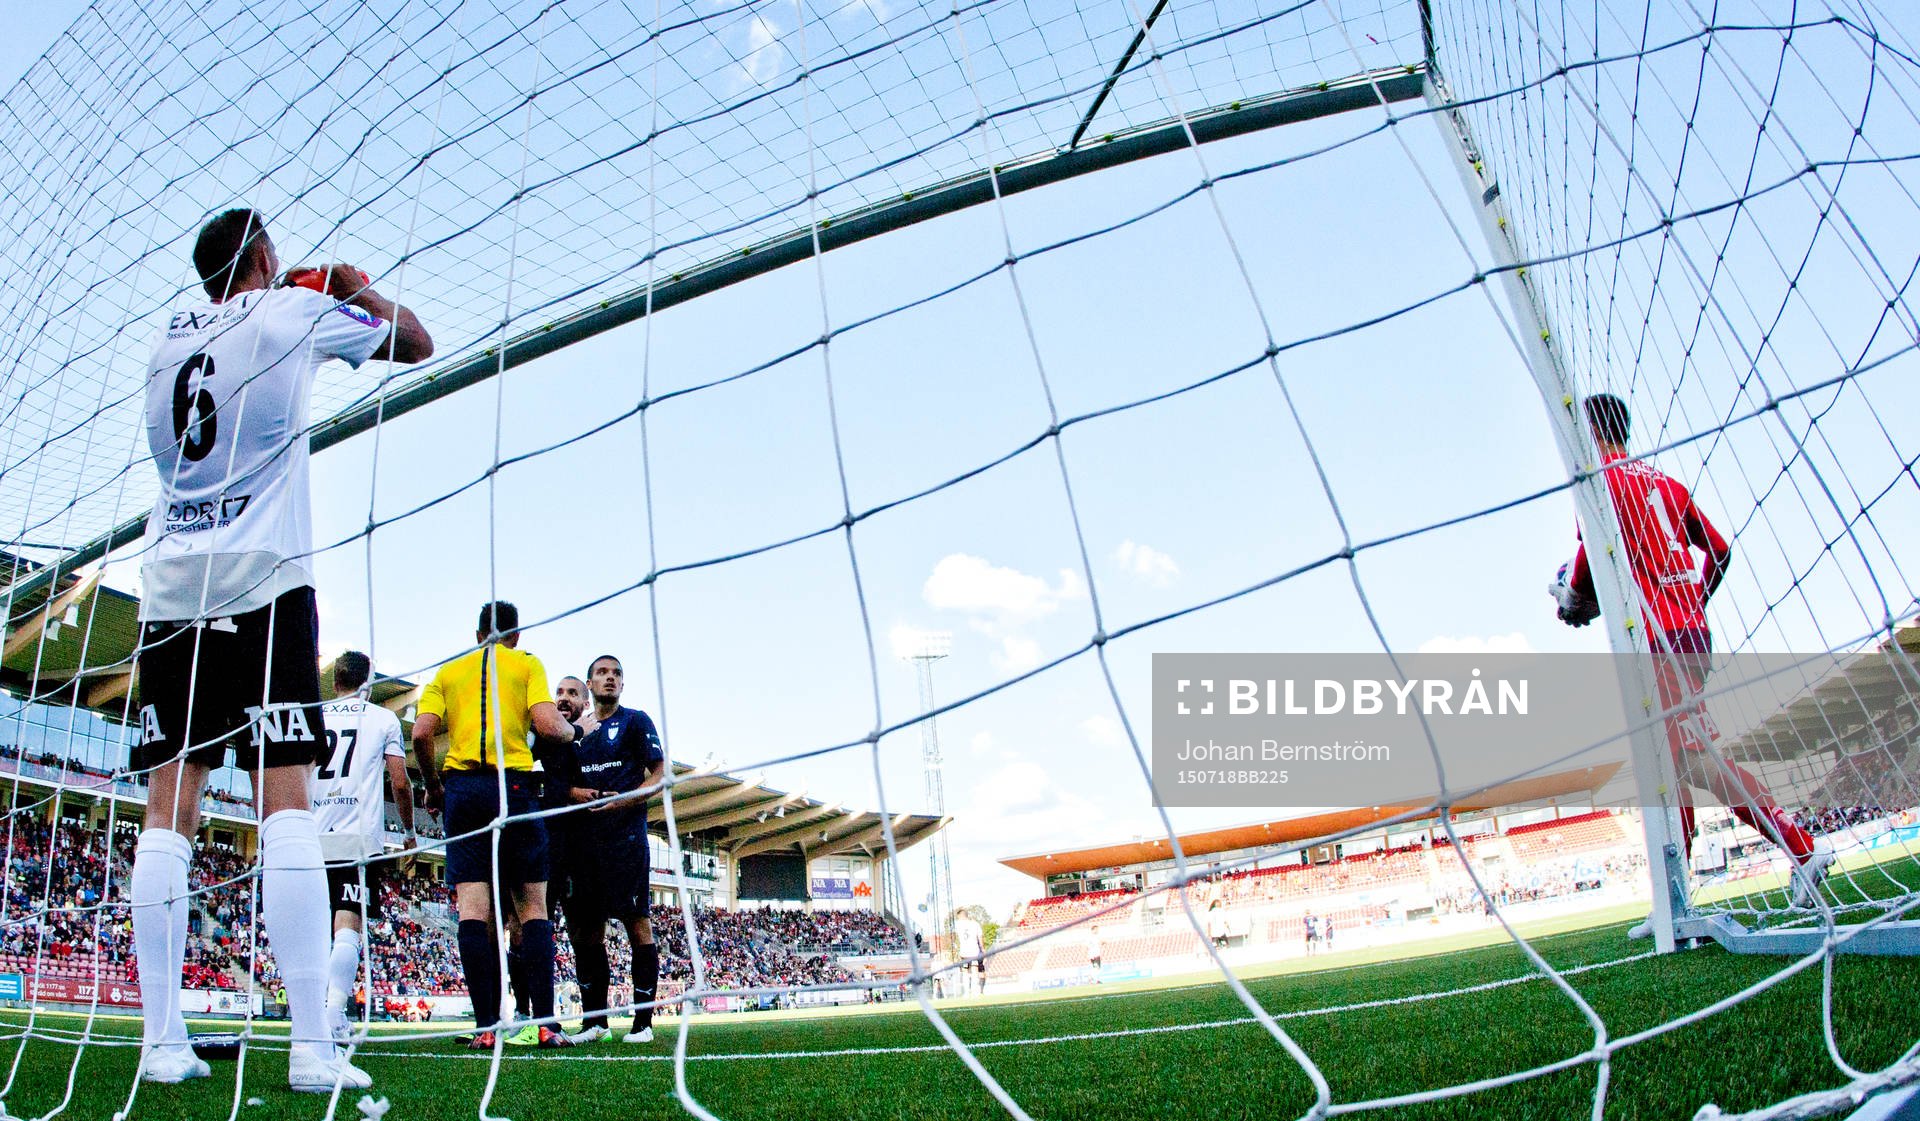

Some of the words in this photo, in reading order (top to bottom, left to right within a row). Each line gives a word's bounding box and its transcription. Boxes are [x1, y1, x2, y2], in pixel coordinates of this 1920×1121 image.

[169, 292, 253, 330] EXACT
[172, 353, 217, 462] 6
[1646, 487, 1684, 552] 1
[244, 701, 316, 747] NA
[317, 728, 358, 780] 27
[813, 879, 825, 887] NA
[834, 879, 847, 887] NA
